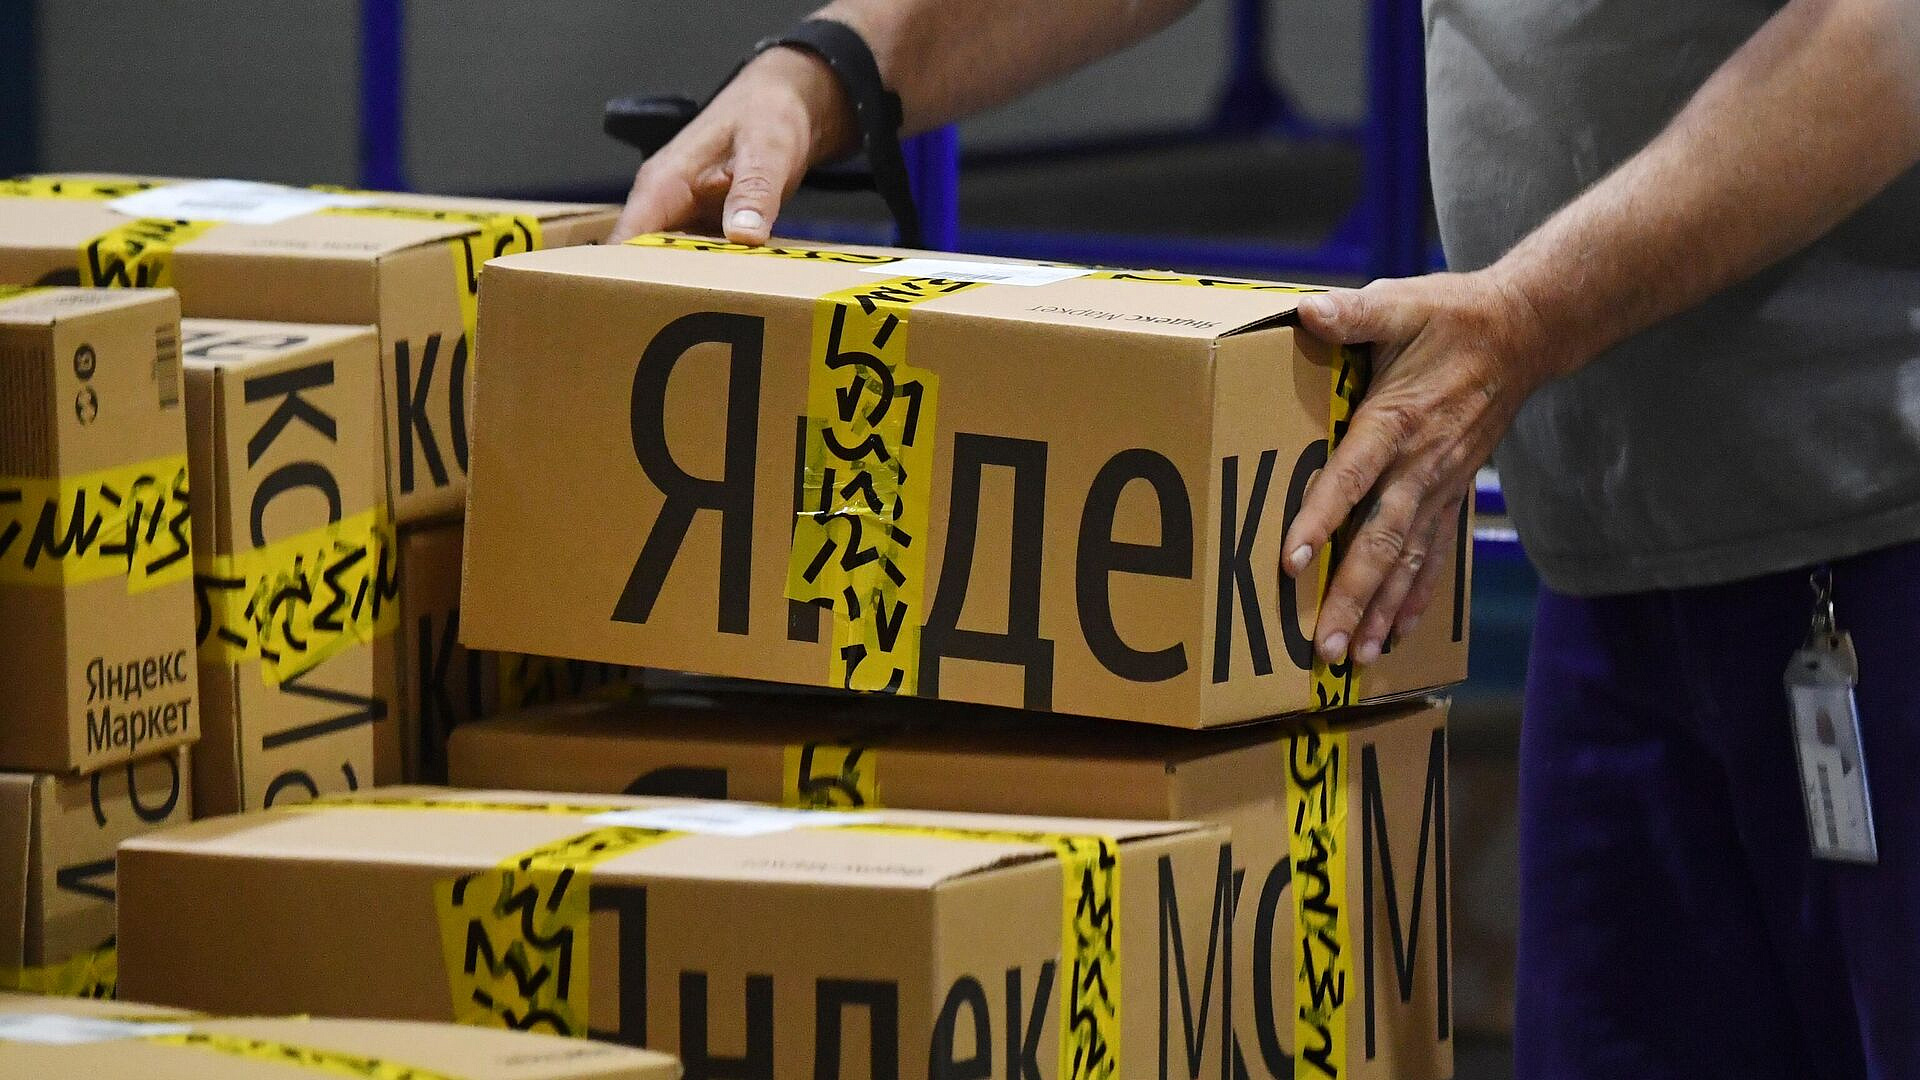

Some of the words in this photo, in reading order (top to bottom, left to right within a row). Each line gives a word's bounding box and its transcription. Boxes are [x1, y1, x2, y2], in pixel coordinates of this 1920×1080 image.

[1025, 304, 1125, 321] Маркет
[1124, 313, 1222, 330] Яндекс
[609, 310, 1330, 712] Ядекс
[85, 649, 188, 705] Яндекс
[86, 697, 192, 757] Маркет
